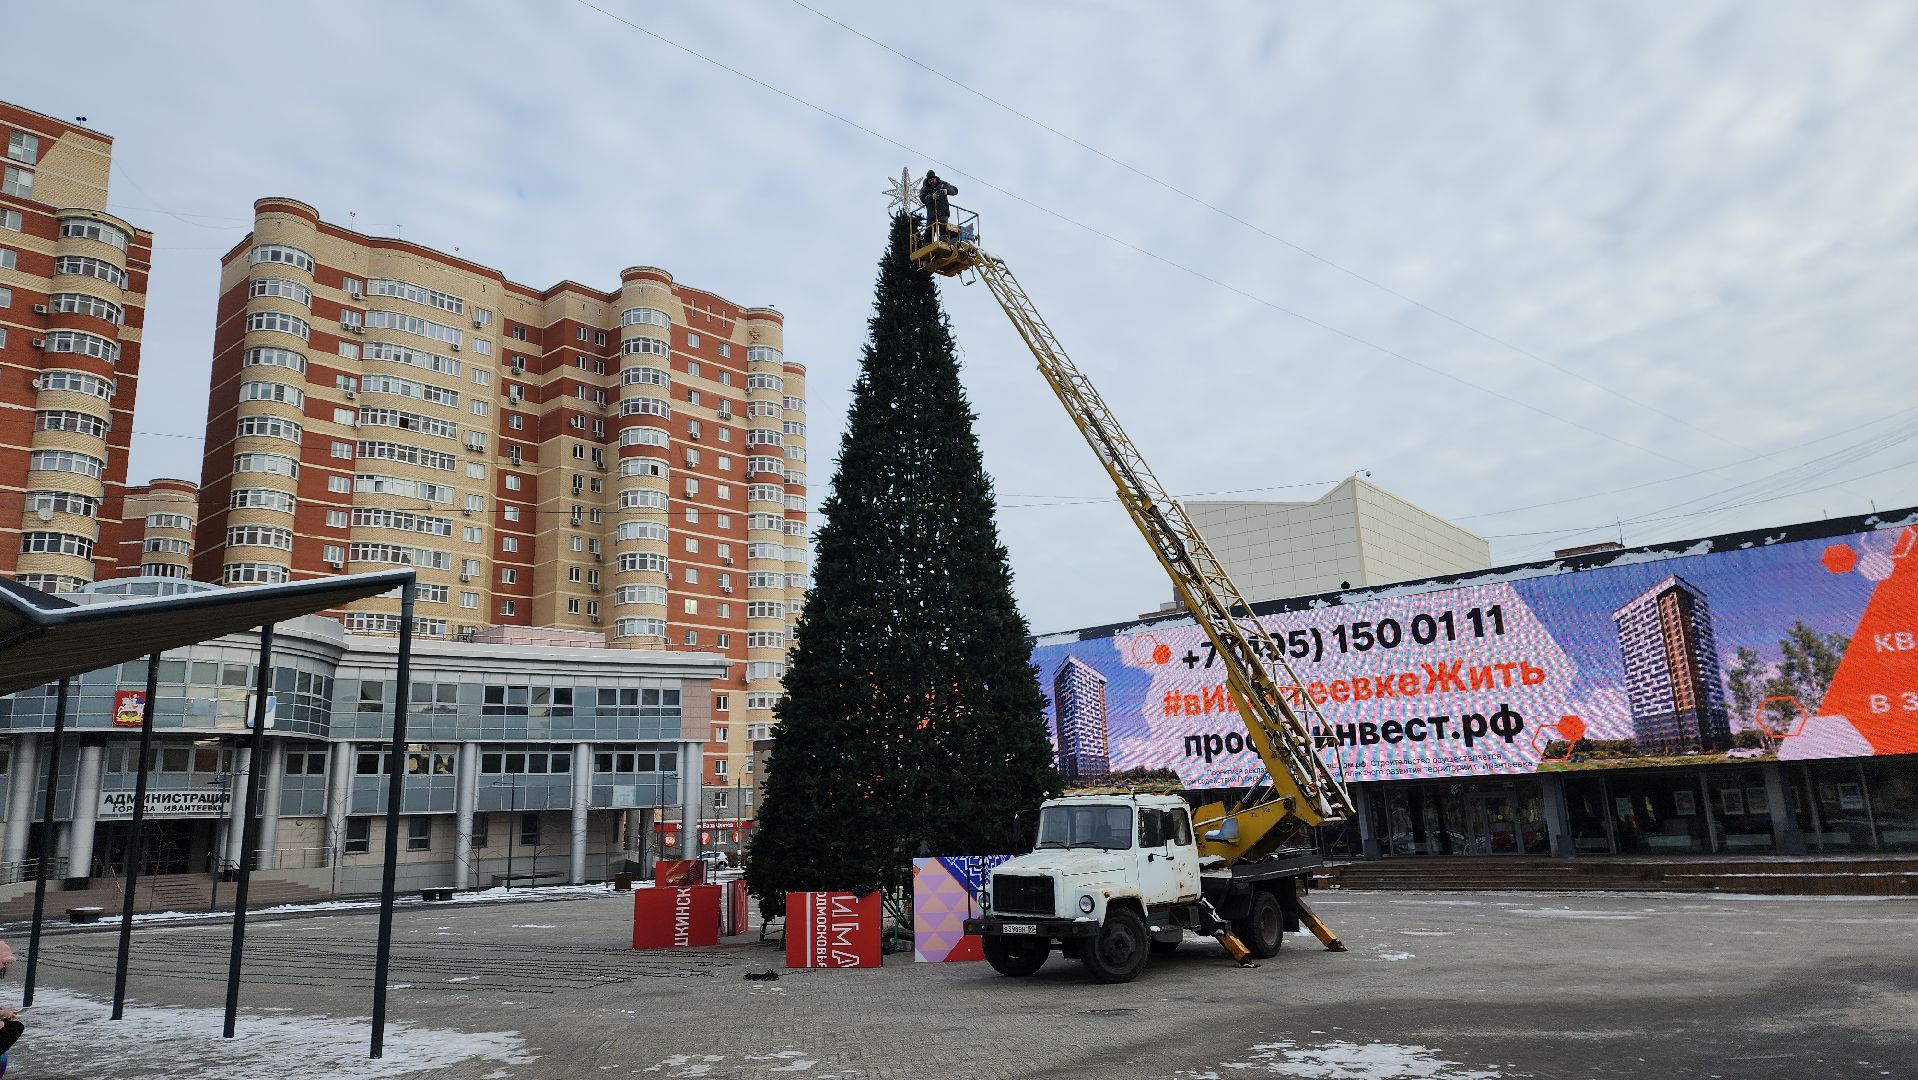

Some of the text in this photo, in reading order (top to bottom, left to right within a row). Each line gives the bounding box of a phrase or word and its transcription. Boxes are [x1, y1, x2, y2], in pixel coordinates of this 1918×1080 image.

[1182, 641, 1217, 670] +7
[1332, 618, 1402, 654] 150
[1411, 611, 1456, 645] 01
[1466, 604, 1505, 638] 11
[1870, 694, 1891, 714] В
[104, 793, 231, 805] АДМИНИСТРАЦИЯ
[112, 804, 156, 813] ГОРДА
